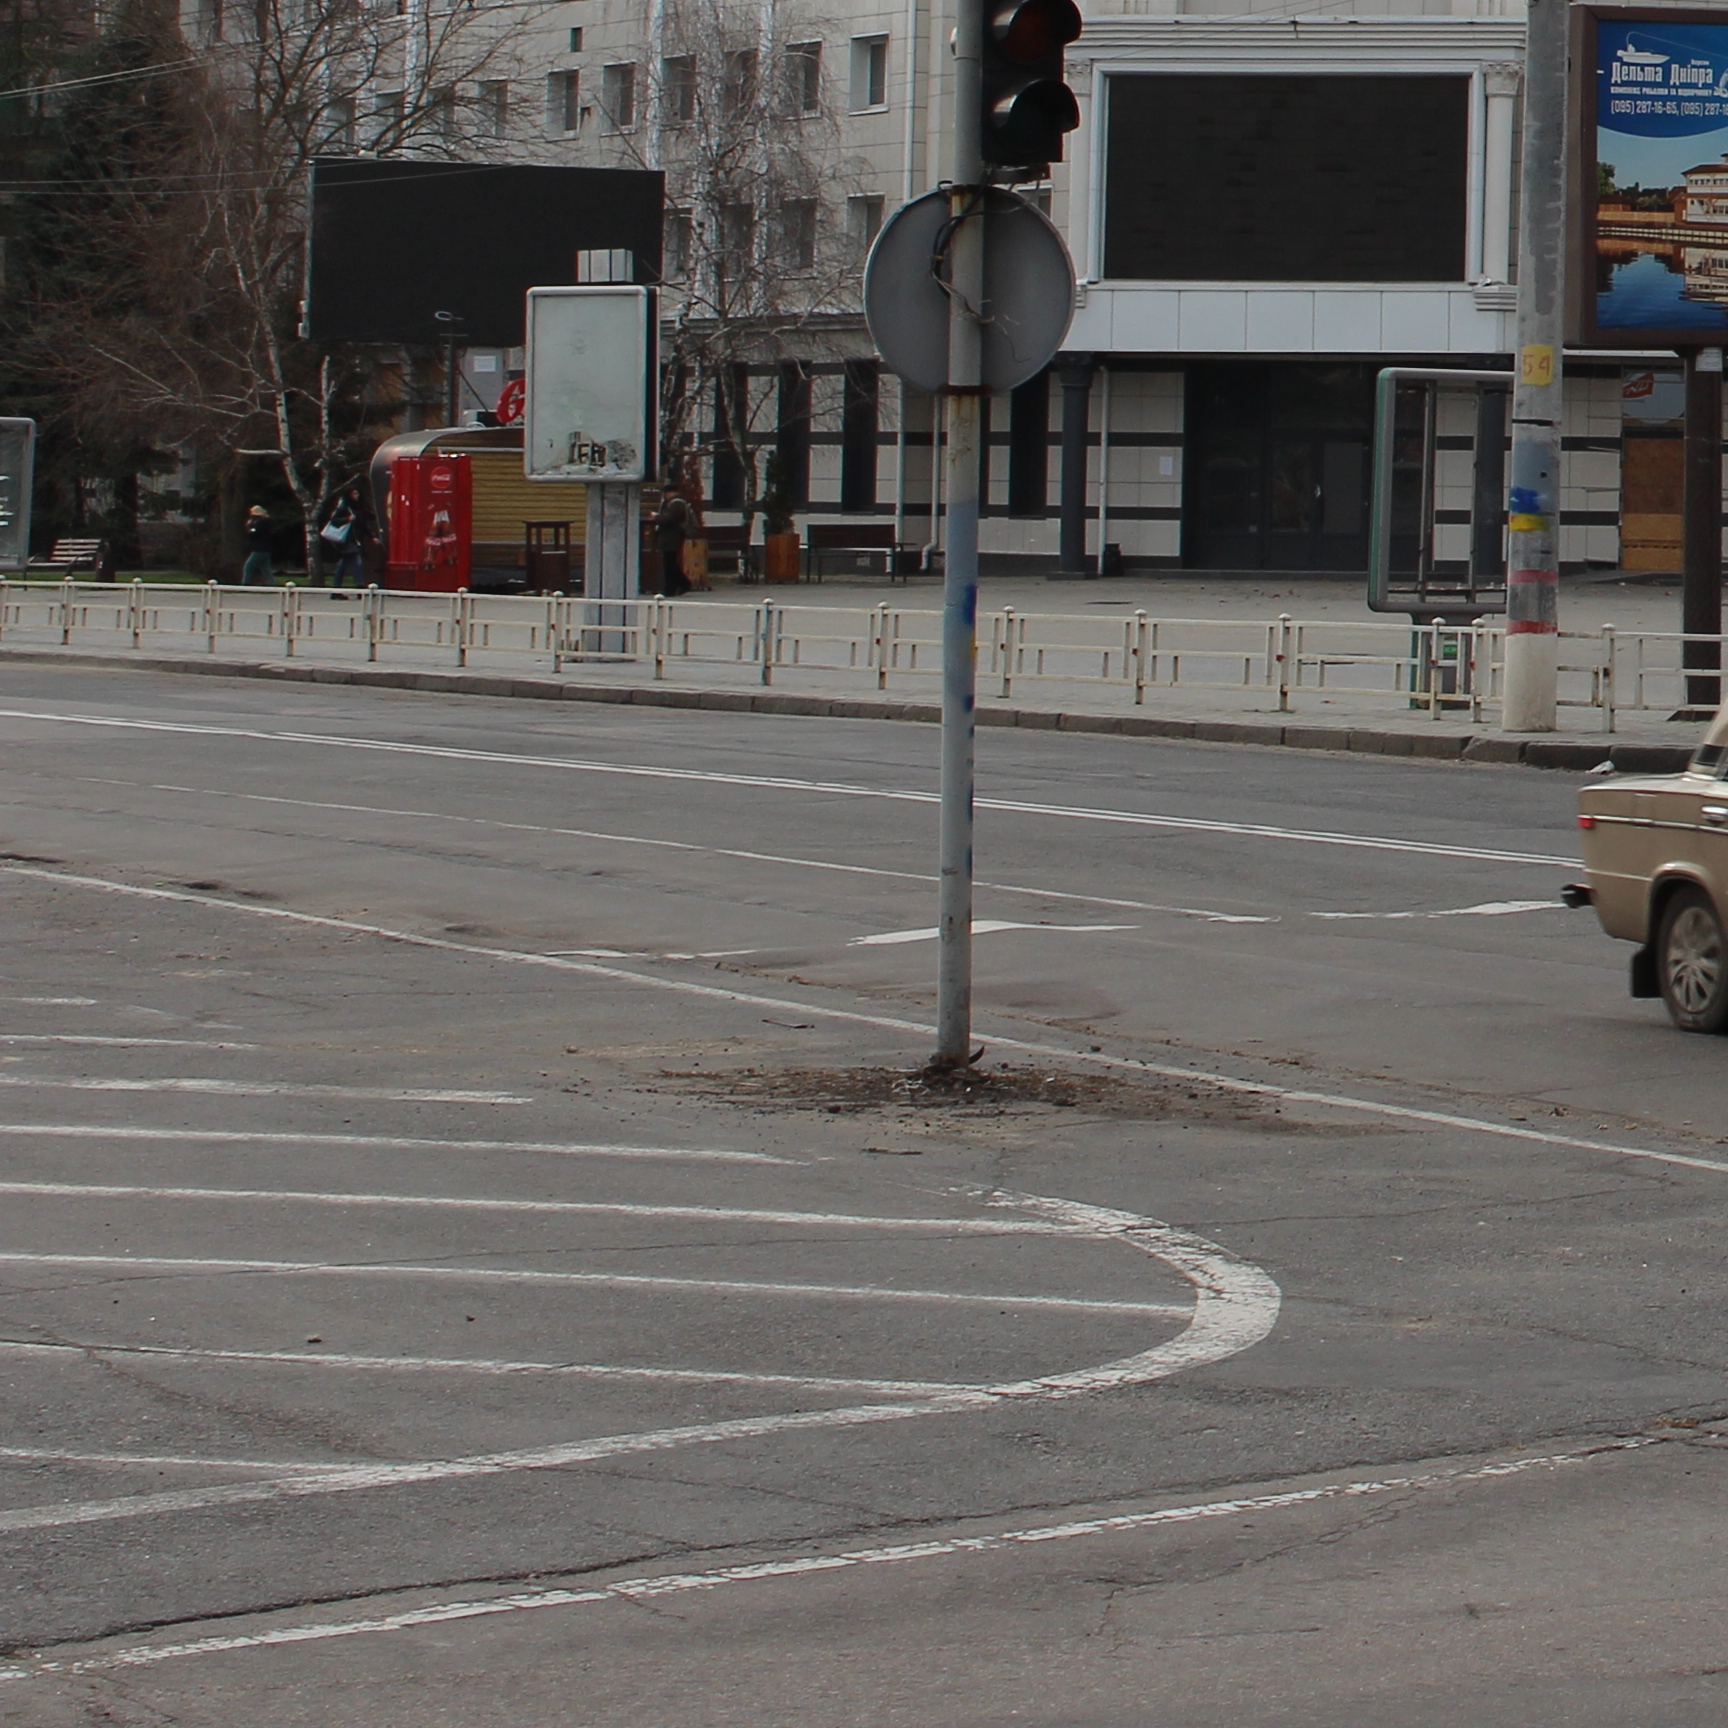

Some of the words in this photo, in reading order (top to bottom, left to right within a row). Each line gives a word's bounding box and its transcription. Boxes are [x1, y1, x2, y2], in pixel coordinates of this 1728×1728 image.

[1611, 62, 1663, 84] Дельта
[1670, 64, 1714, 88] Дніпра
[1611, 100, 1635, 115] (095)
[1636, 101, 1679, 116] 287-16-65,
[1680, 102, 1703, 117] (095)
